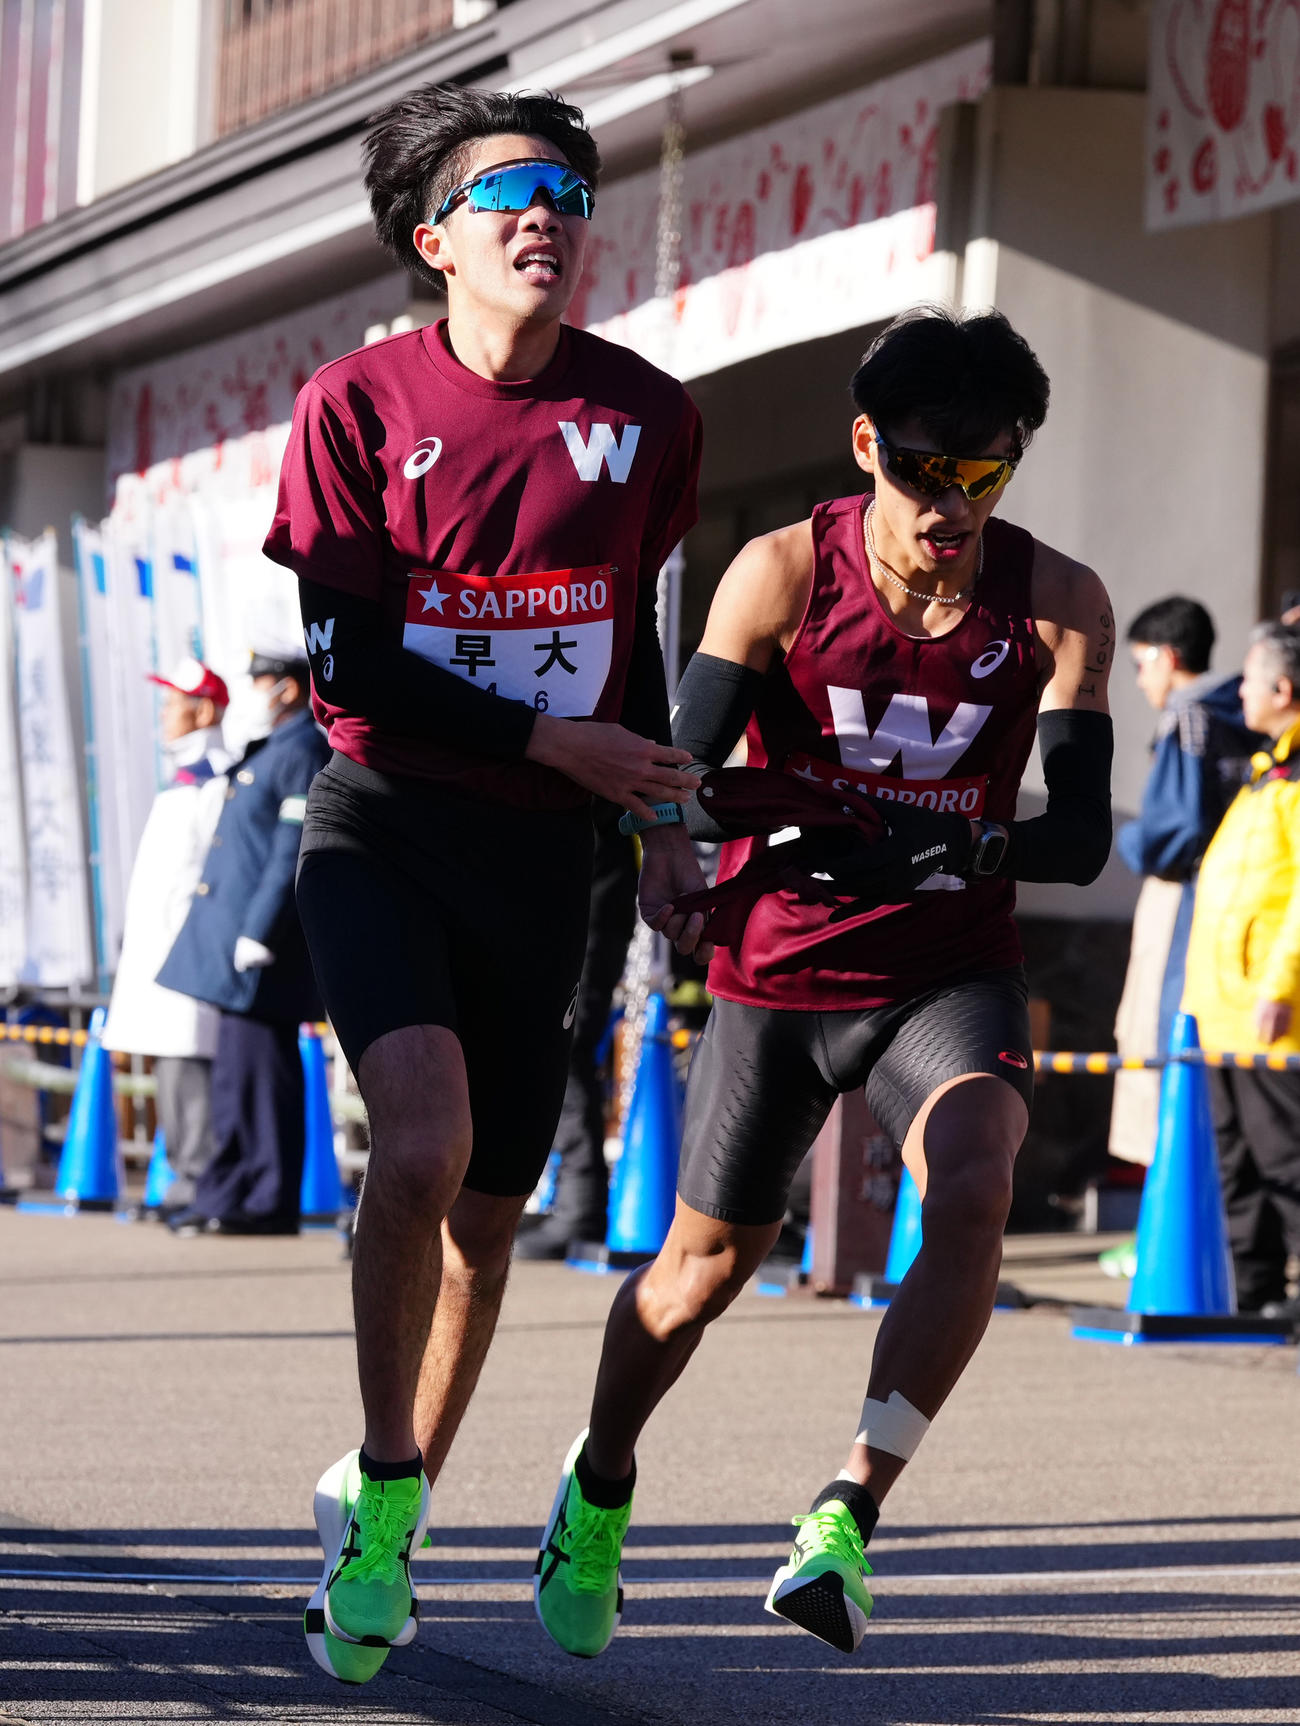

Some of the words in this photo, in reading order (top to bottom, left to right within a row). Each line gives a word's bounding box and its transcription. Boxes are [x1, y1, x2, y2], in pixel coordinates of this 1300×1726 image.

[557, 421, 642, 484] W
[457, 579, 608, 619] SAPPORO
[303, 617, 336, 656] W
[449, 630, 578, 678] 早大
[1084, 612, 1111, 674] love
[826, 684, 994, 781] W
[911, 843, 948, 865] WASEDA
